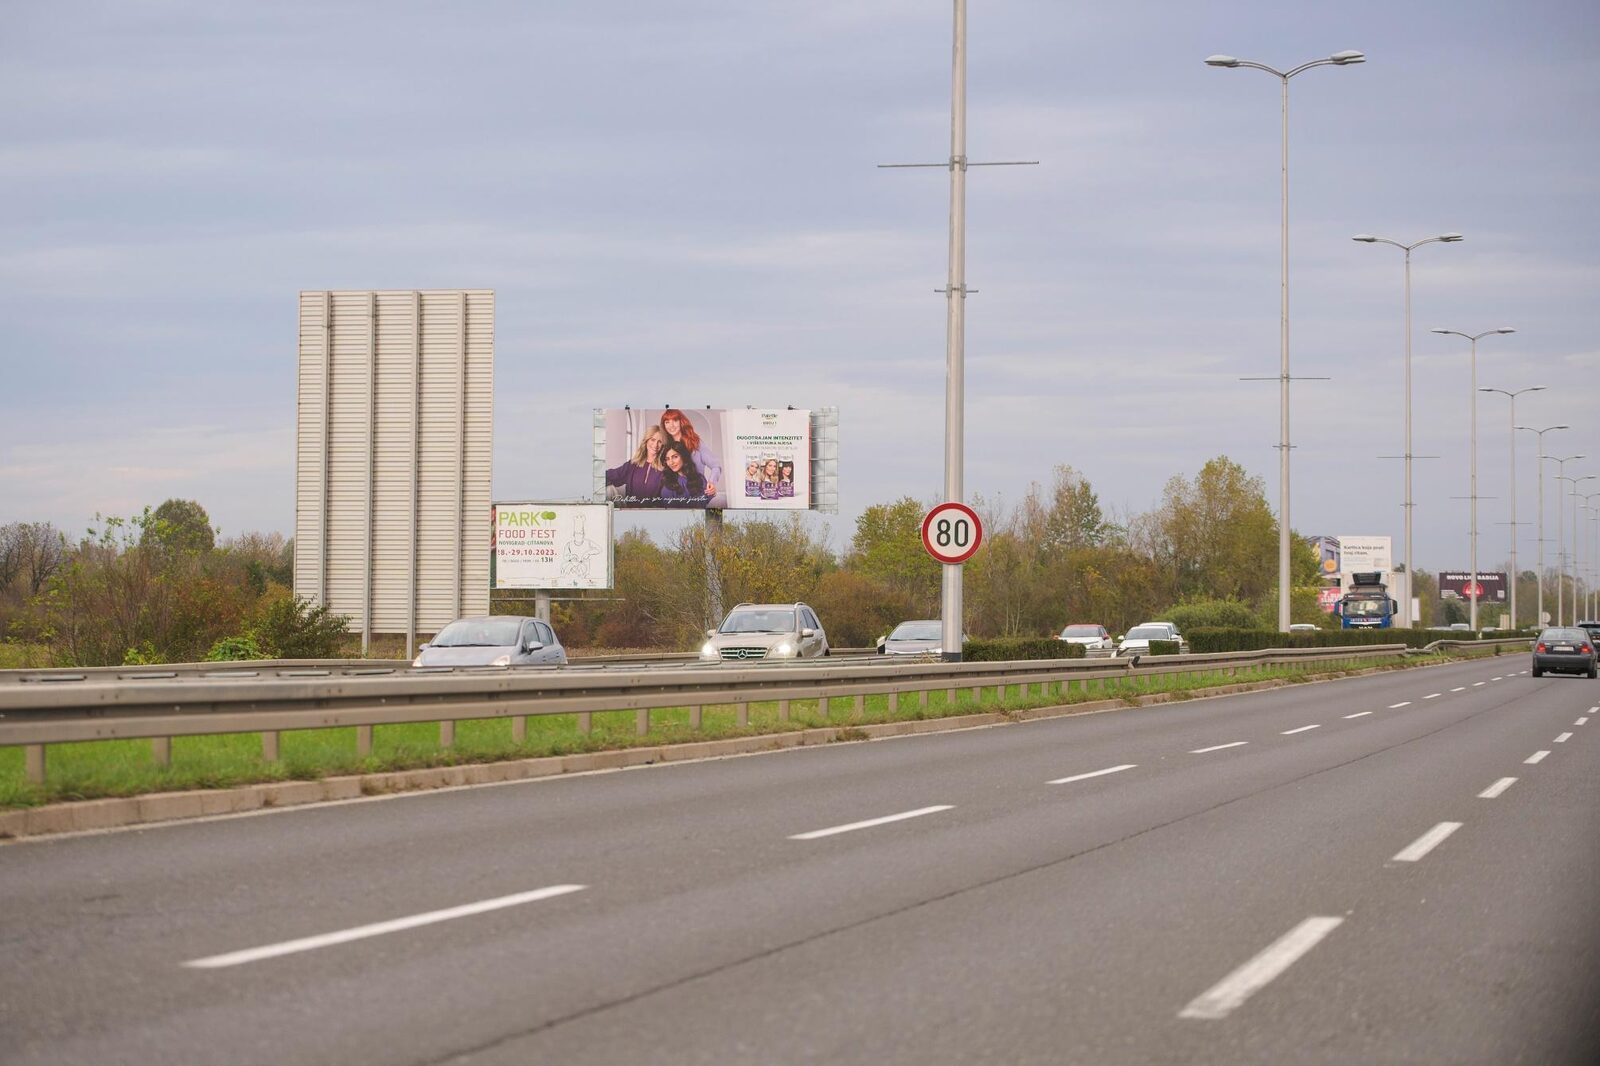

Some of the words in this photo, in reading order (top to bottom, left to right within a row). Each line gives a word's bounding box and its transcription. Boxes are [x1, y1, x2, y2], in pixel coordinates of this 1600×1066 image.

[498, 511, 541, 527] PARK
[498, 529, 526, 539] FOOD
[531, 529, 557, 539] FEST
[937, 519, 968, 547] 80
